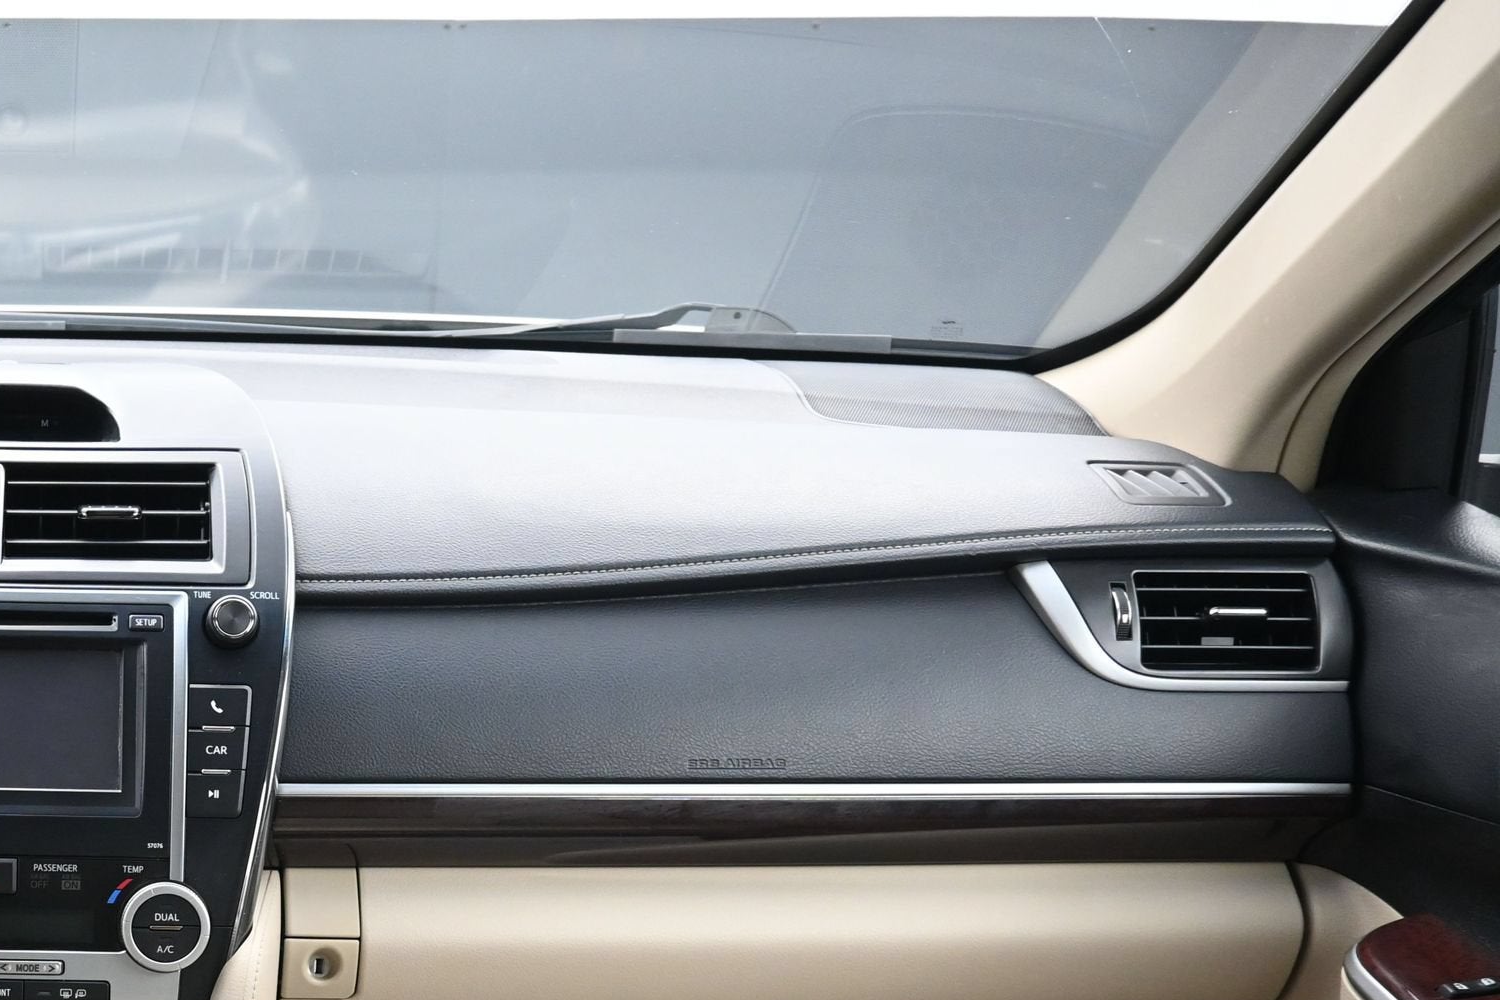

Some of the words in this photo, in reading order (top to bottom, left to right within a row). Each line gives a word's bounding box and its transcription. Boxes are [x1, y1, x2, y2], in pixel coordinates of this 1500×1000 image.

[193, 591, 213, 599] TUNE
[249, 591, 280, 600] SCROLL
[134, 618, 158, 626] SETUP
[205, 745, 229, 755] CAR
[33, 863, 79, 873] PASSENGER
[122, 865, 145, 874] TEMP
[30, 879, 49, 889] OFF
[63, 880, 80, 890] ON
[154, 912, 180, 922] DUAL
[156, 945, 175, 954] A/C
[16, 963, 40, 973] MODE
